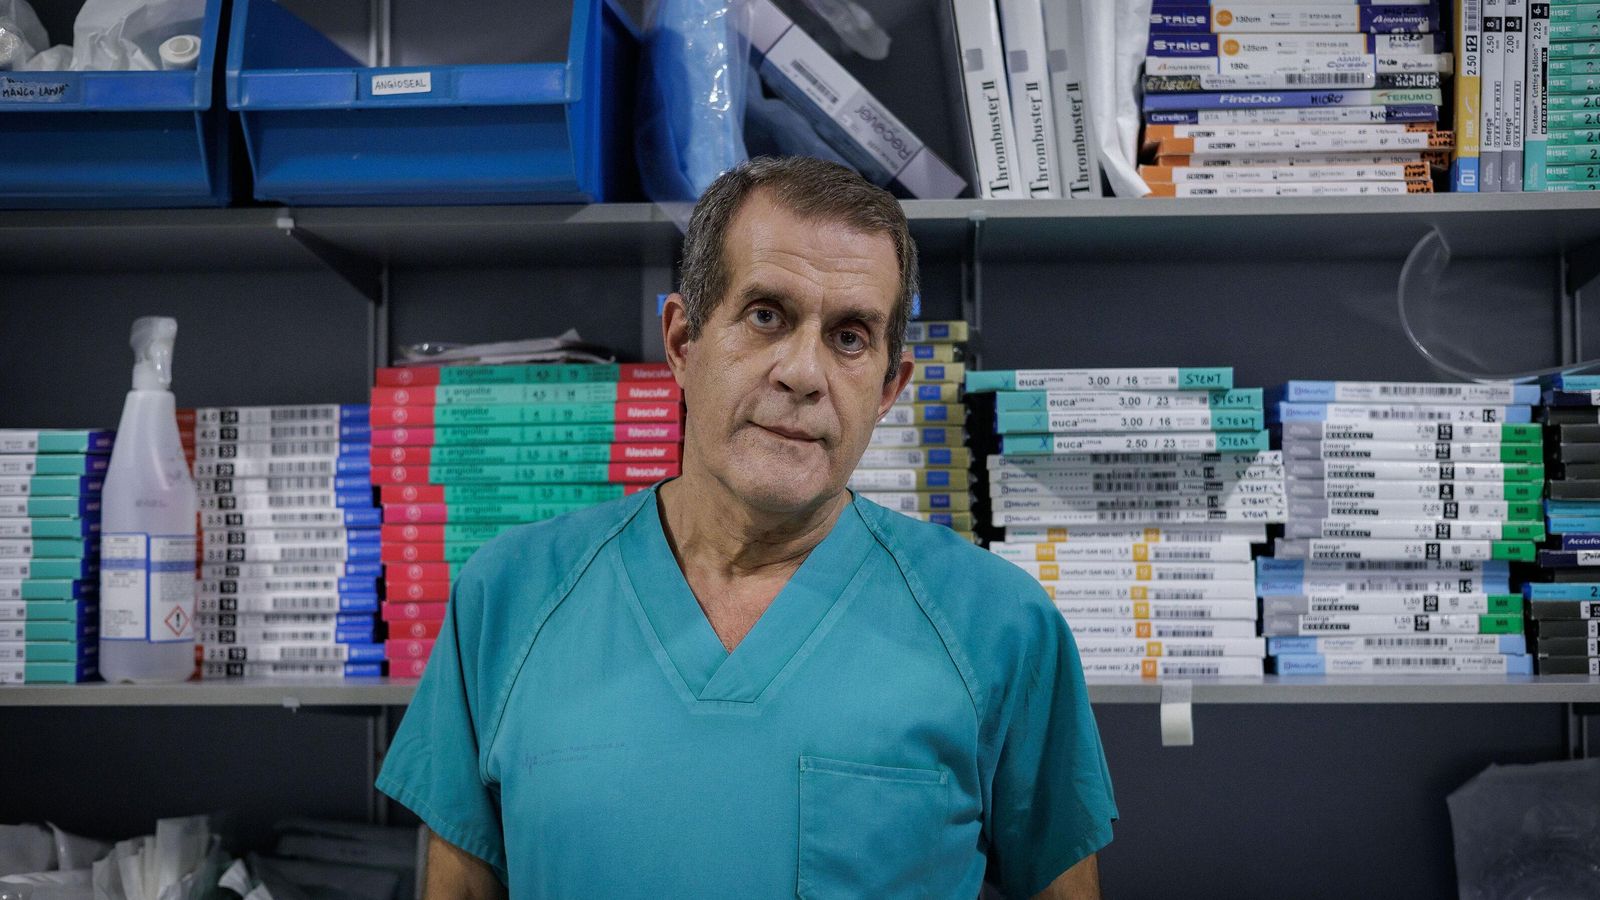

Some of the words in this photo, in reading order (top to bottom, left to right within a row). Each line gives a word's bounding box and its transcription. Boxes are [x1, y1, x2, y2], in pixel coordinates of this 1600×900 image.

[1150, 14, 1206, 24] STRIDE
[1534, 21, 1542, 40] 2.25
[1154, 40, 1210, 51] STRIDE
[1467, 38, 1478, 52] 12
[1486, 35, 1494, 54] 2.50
[1506, 35, 1514, 54] 2.00
[1467, 55, 1477, 76] 2.50
[374, 79, 426, 91] ANGIOSEAL
[982, 81, 995, 90] II
[1026, 82, 1038, 91] II
[1066, 83, 1079, 92] II
[1532, 77, 1540, 99] Cutting
[1220, 95, 1281, 104] FineDuo
[1494, 81, 1502, 147] OVER-THE-WIRE
[1514, 81, 1522, 147] OVER-THE-WIRE
[988, 95, 1010, 198] Thrombuster
[1029, 96, 1050, 199] Thrombuster
[1069, 97, 1090, 199] Thrombuster
[1088, 376, 1110, 386] 3.00
[1126, 376, 1138, 386] 16
[1185, 374, 1221, 386] STENT
[1119, 396, 1141, 406] 3.00
[1156, 397, 1169, 406] 23
[1212, 394, 1252, 406] STENT
[1120, 418, 1142, 428] 3.00
[1160, 418, 1171, 427] 16
[1217, 418, 1256, 430] STENT
[1417, 426, 1435, 434] 2.50
[1126, 440, 1148, 450] 2.50
[1163, 440, 1176, 450] 23
[1219, 436, 1257, 448] STENT
[1419, 467, 1437, 475] 2.50
[1418, 486, 1436, 494] 2.50
[1443, 486, 1449, 494] 8
[1422, 505, 1441, 513] 2.25
[1415, 526, 1433, 534] 2.25
[1404, 546, 1422, 554] 2.25
[1428, 544, 1439, 554] 12
[1403, 598, 1420, 606] 1.50
[1394, 617, 1412, 625] 1.50
